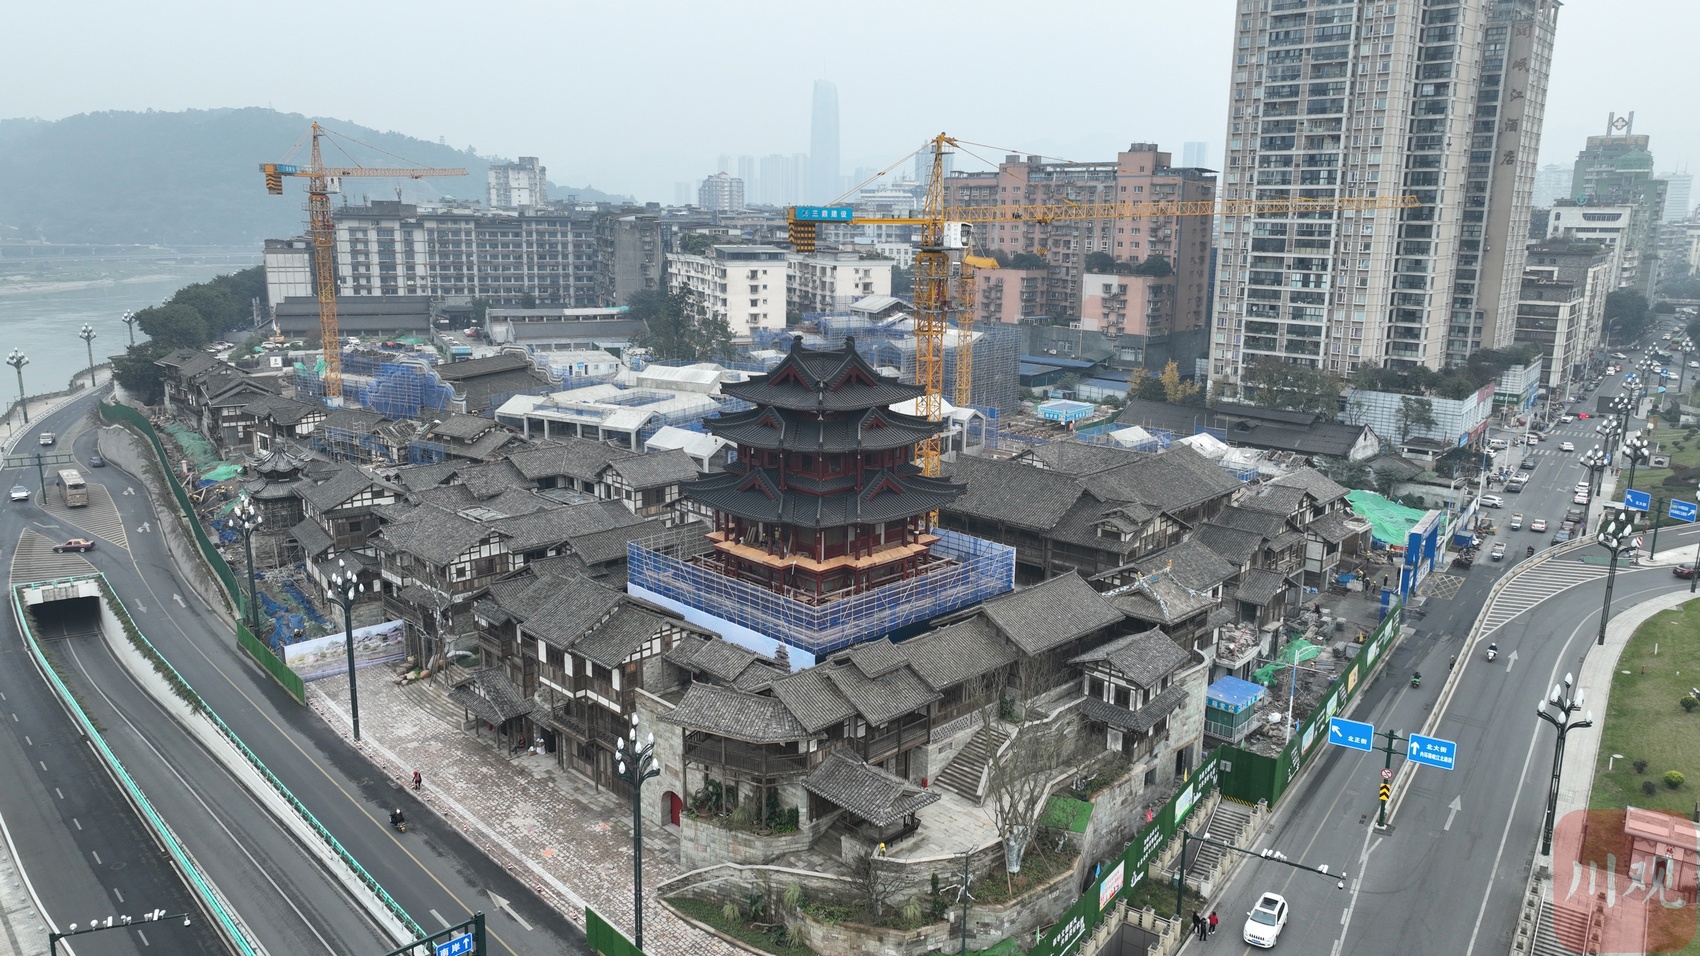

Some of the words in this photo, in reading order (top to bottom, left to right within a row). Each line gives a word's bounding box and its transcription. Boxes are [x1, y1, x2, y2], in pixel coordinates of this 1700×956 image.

[812, 209, 848, 219] 三鼎建设
[1348, 736, 1367, 745] 北正街
[1426, 744, 1447, 753] 北大街
[440, 942, 460, 956] 南岸
